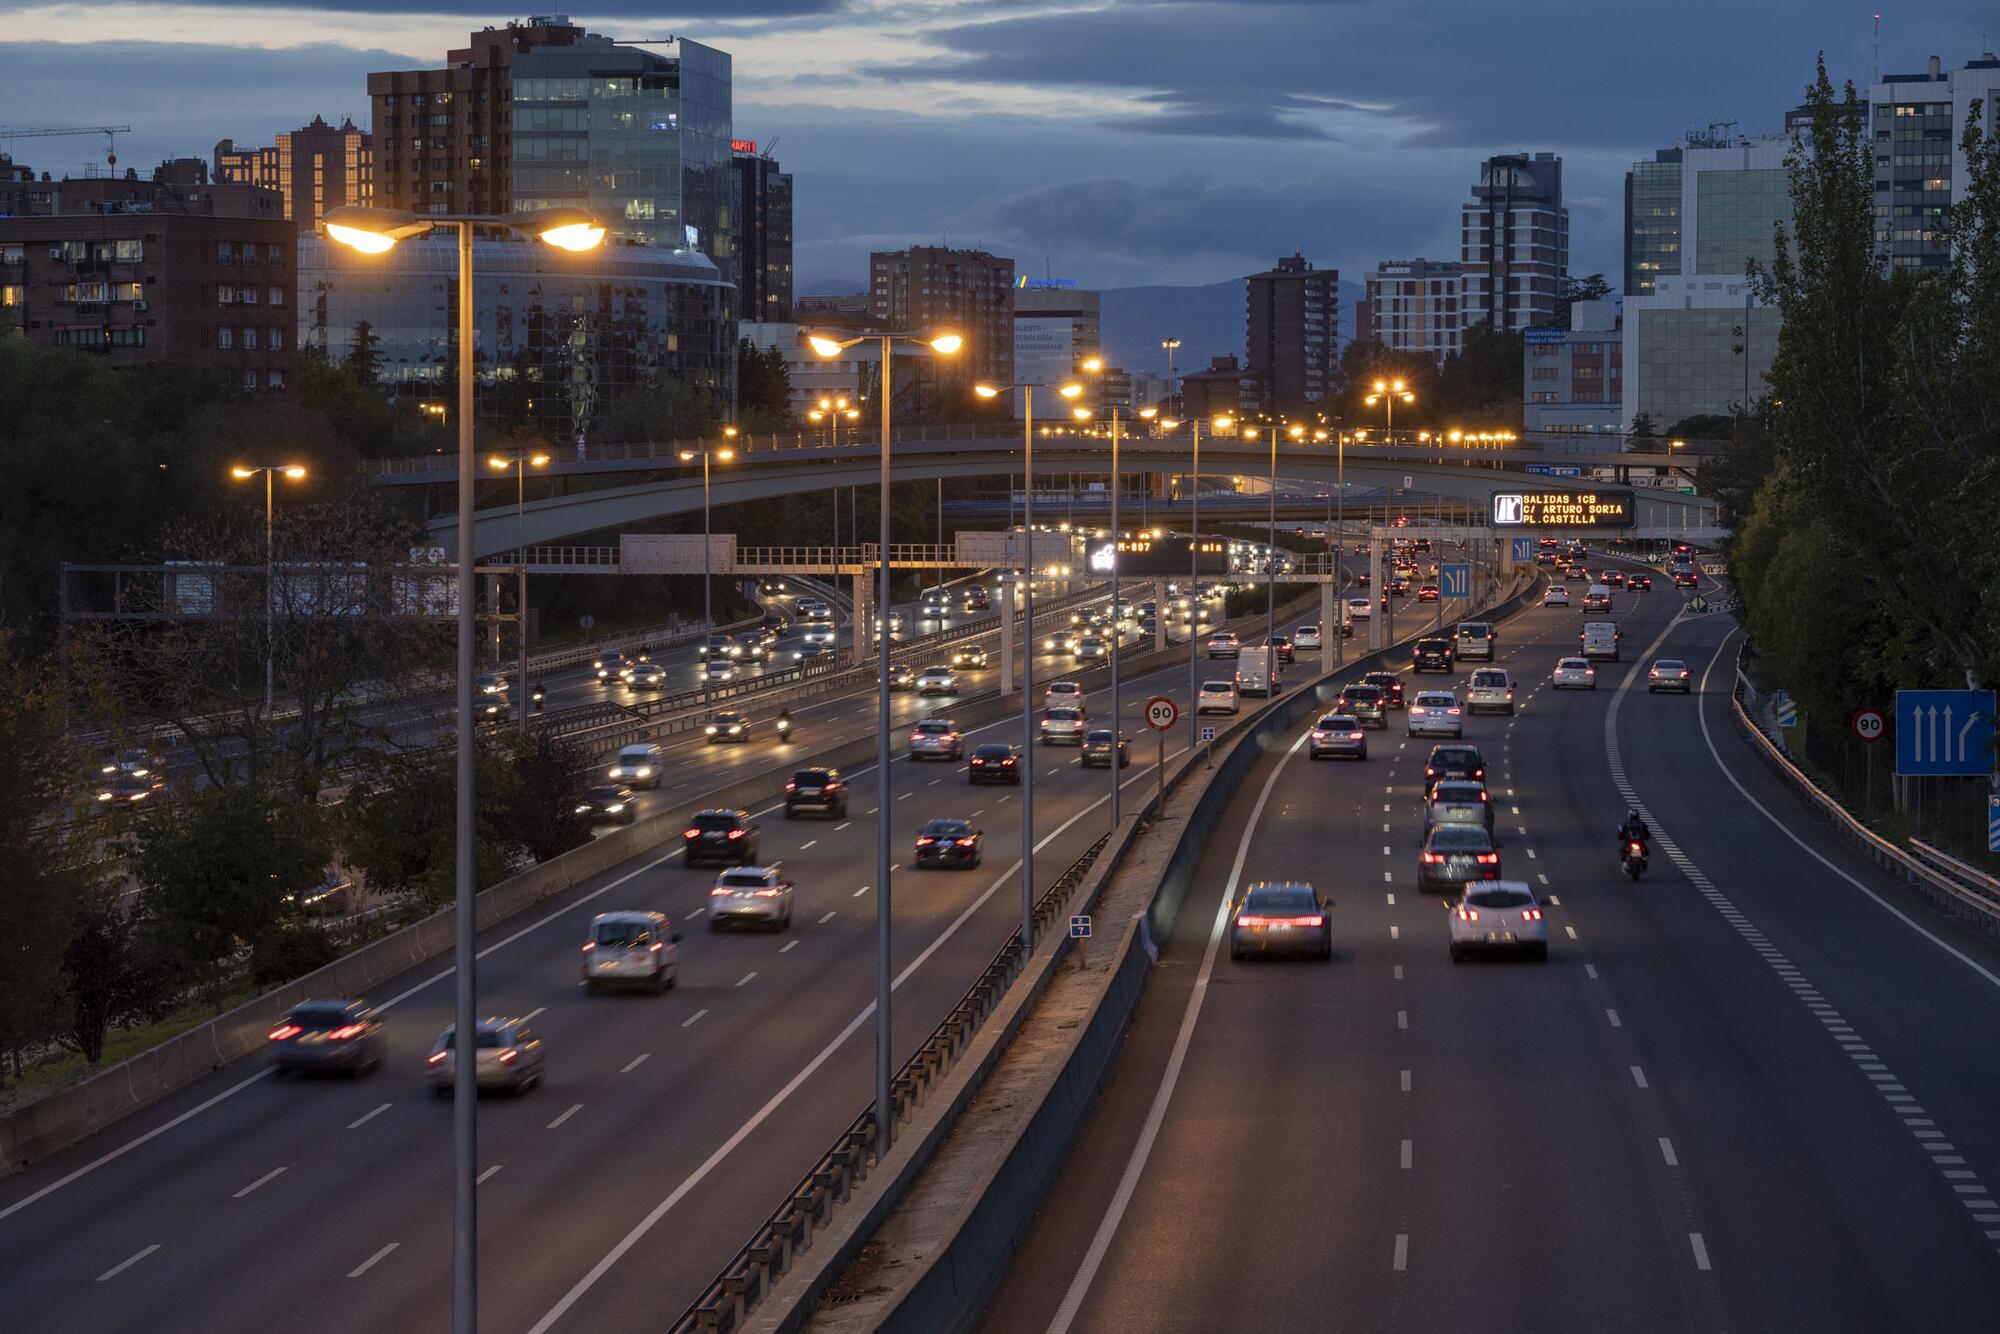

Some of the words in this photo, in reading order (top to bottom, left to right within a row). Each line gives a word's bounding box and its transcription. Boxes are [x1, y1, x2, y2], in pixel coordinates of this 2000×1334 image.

[1523, 495, 1569, 504] SALIDAS
[1577, 495, 1596, 504] 1CB
[1523, 505, 1535, 514] C/
[1543, 505, 1582, 514] ARTURO
[1589, 505, 1622, 514] SORIA
[1523, 515, 1596, 524] PL.CASTILLA
[1202, 543, 1222, 552] min
[1152, 707, 1171, 719] 90
[1860, 719, 1880, 730] 90
[1077, 926, 1085, 935] 7
